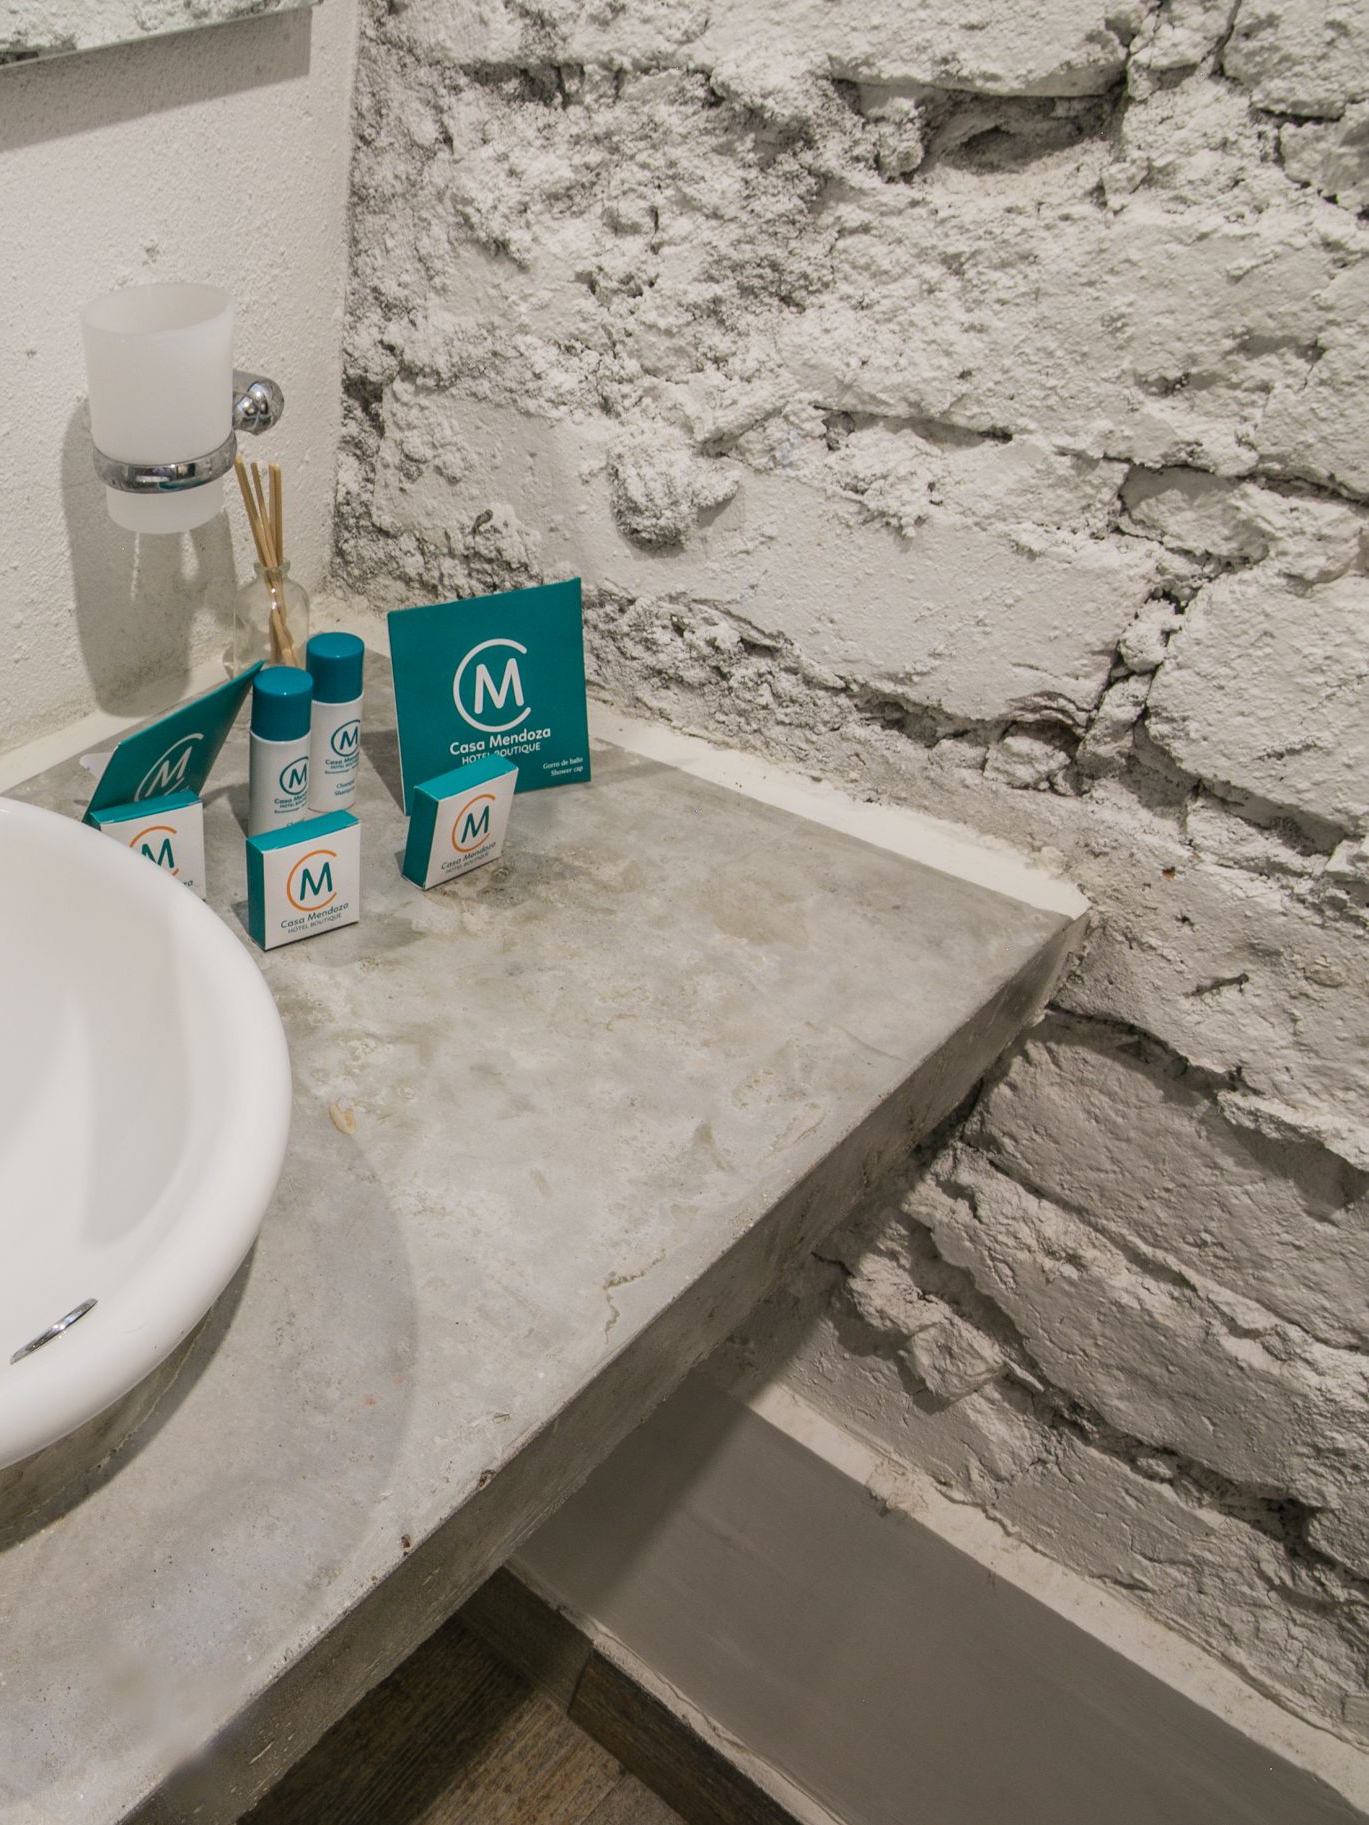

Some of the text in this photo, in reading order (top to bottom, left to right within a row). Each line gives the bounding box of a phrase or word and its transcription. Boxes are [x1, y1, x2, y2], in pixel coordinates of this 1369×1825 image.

[450, 728, 551, 755] Casa Mendoza
[551, 768, 572, 776] Shower
[441, 857, 461, 870] Casa
[280, 902, 349, 928] Casa Mendoza
[288, 913, 342, 934] HOTEL BOUTIQUE
